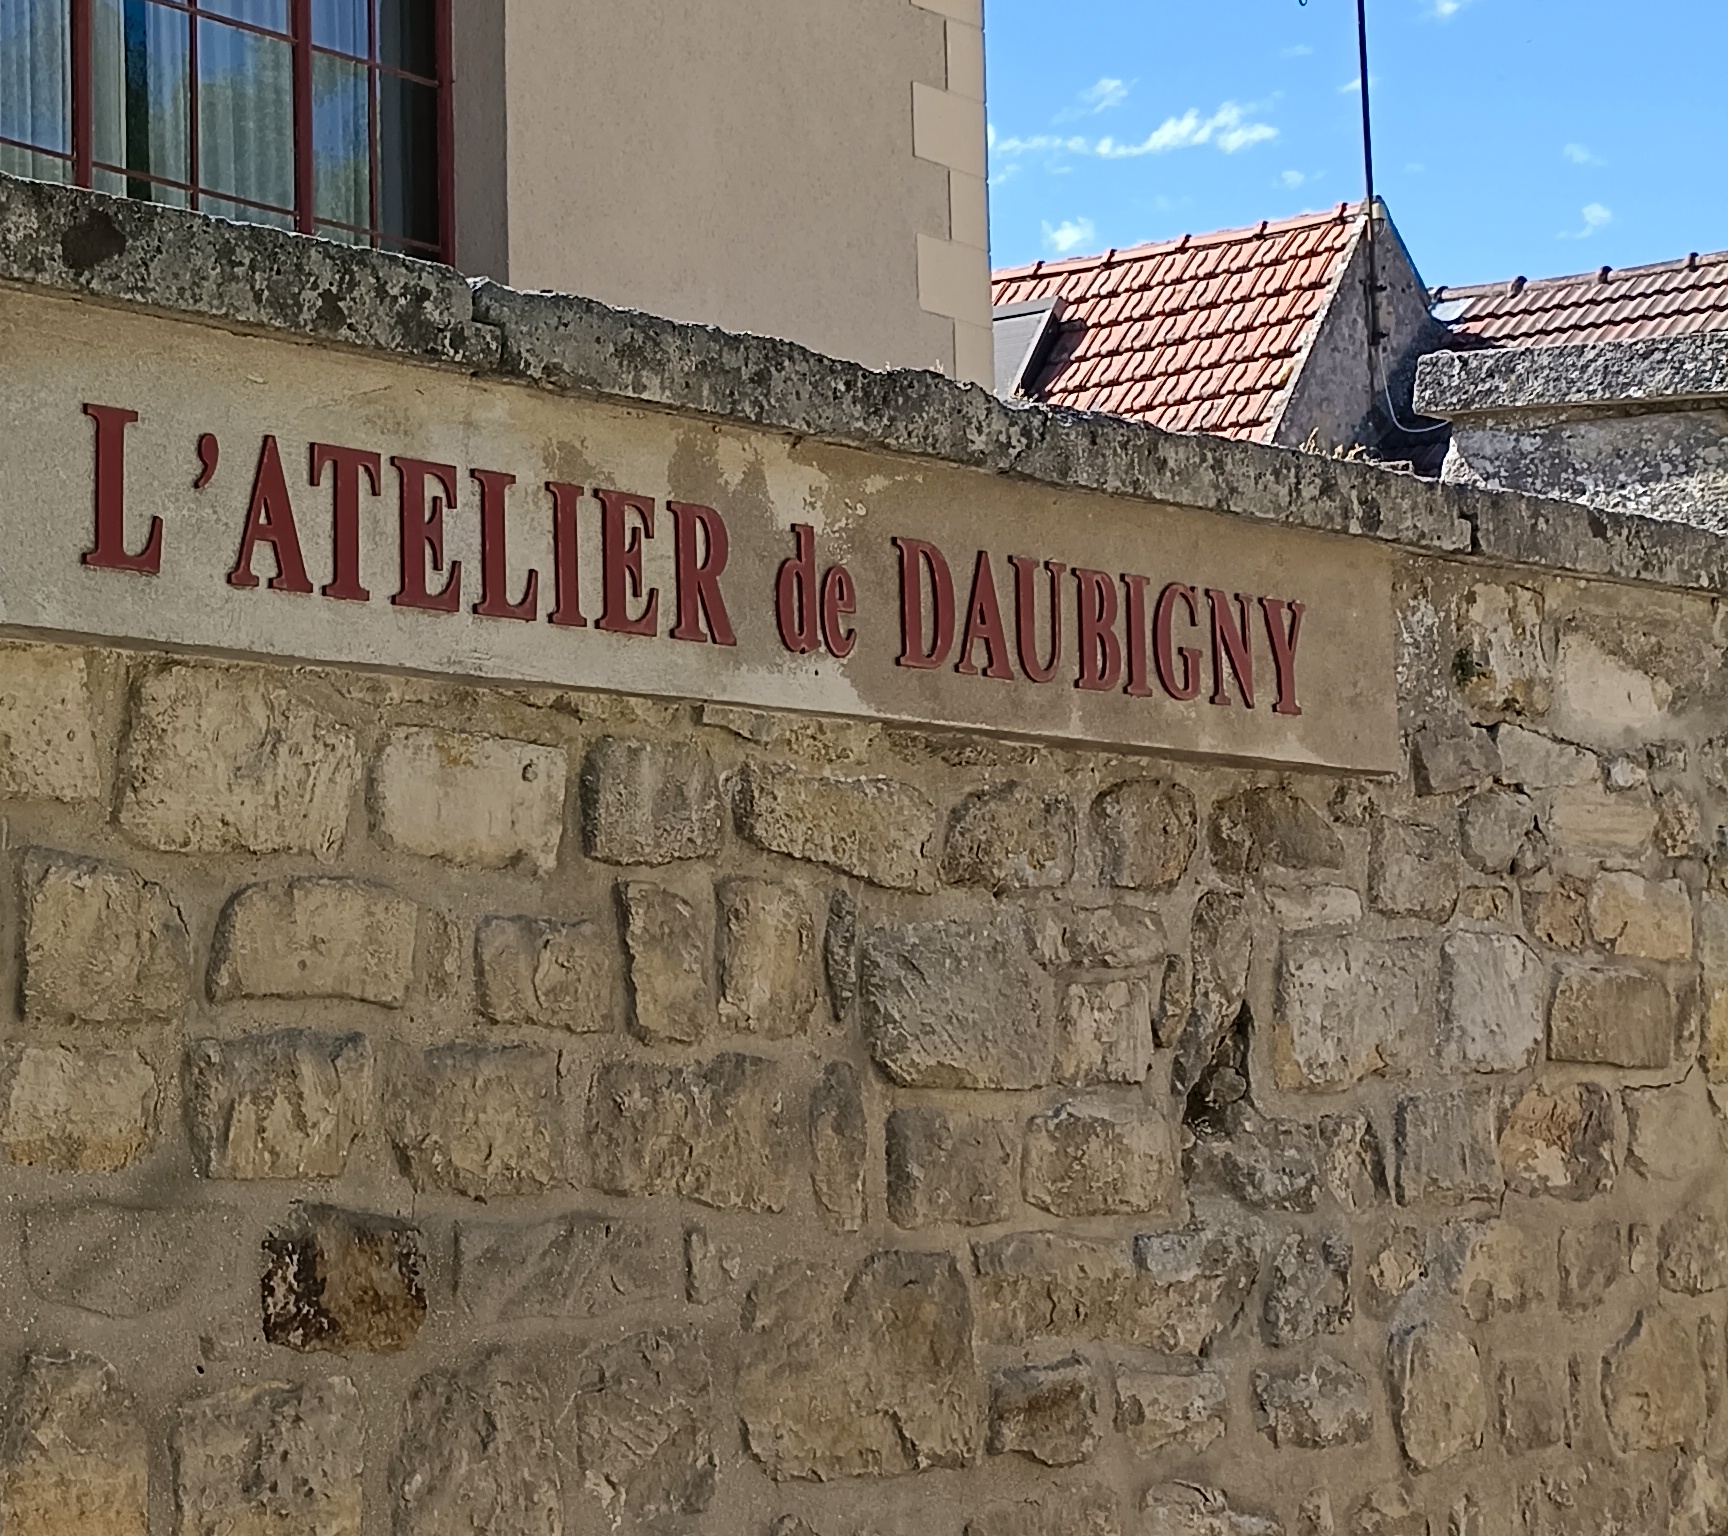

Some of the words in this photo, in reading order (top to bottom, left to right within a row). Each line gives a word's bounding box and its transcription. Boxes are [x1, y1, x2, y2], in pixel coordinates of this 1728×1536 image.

[81, 402, 738, 646] L'ATELIER
[775, 523, 858, 658] de
[890, 536, 1306, 717] DAUBIGNY
